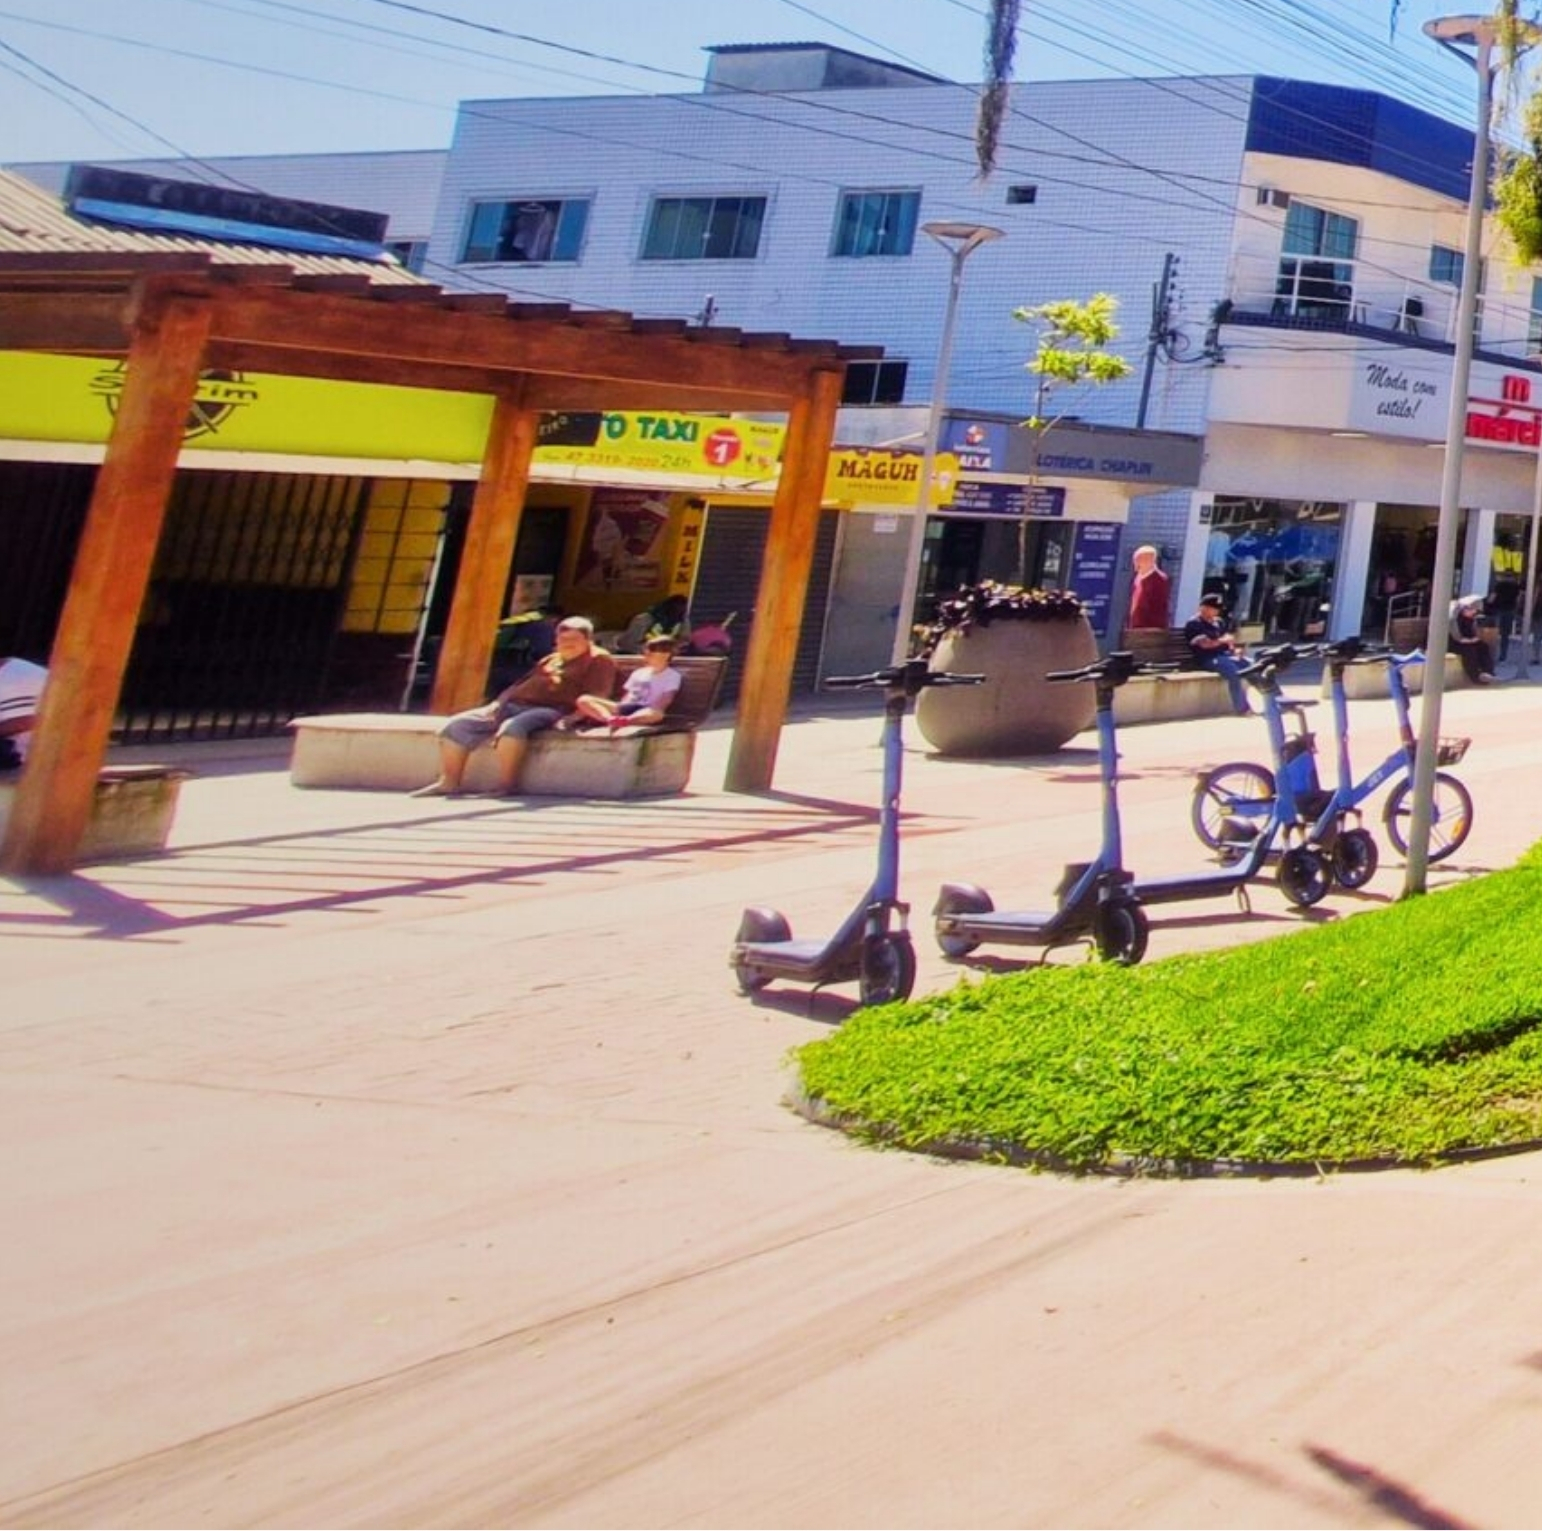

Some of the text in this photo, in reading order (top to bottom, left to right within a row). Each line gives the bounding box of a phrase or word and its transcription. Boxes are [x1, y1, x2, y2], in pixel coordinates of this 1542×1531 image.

[1367, 364, 1437, 396] Moda com
[1377, 397, 1422, 420] estilo!
[636, 417, 700, 442] TAXI
